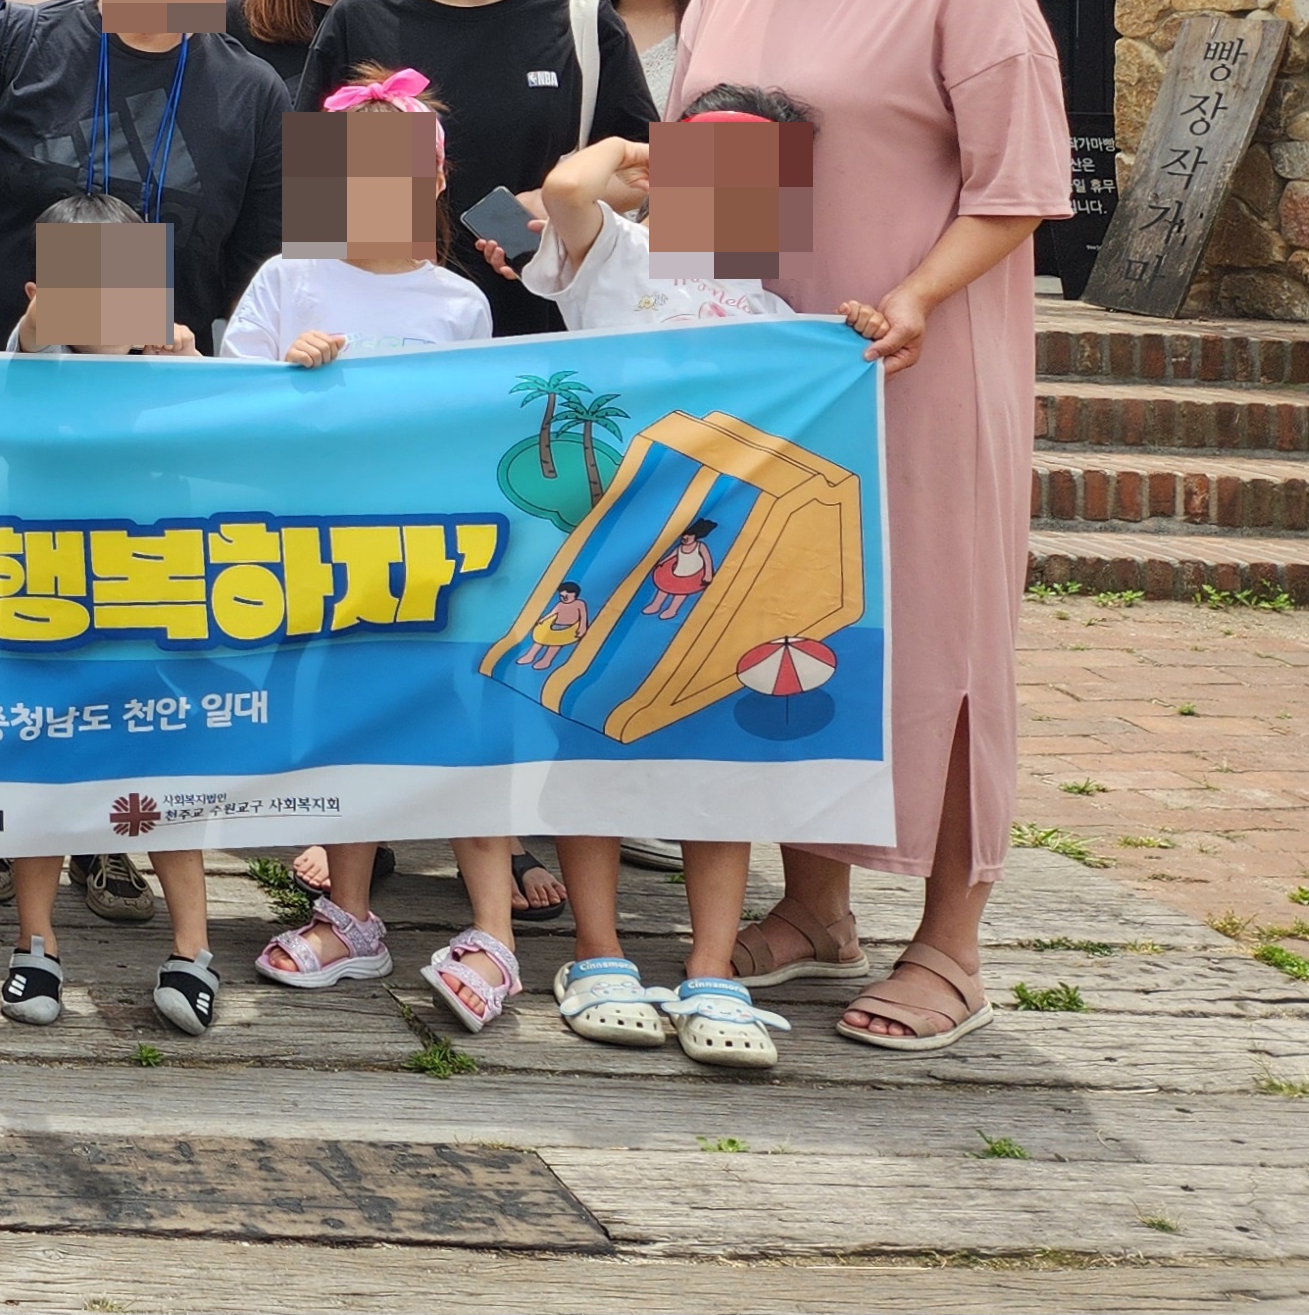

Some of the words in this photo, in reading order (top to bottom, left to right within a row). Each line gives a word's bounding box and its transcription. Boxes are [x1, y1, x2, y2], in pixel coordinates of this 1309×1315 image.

[537, 71, 559, 87] NBA
[1090, 179, 1116, 194] 휴무
[123, 696, 191, 733] 천안
[200, 690, 268, 729] 일대
[163, 792, 227, 806] 사회복지법인
[165, 807, 204, 822] 천주교
[209, 799, 263, 817] 수원교구
[269, 797, 341, 813] 사회복지회
